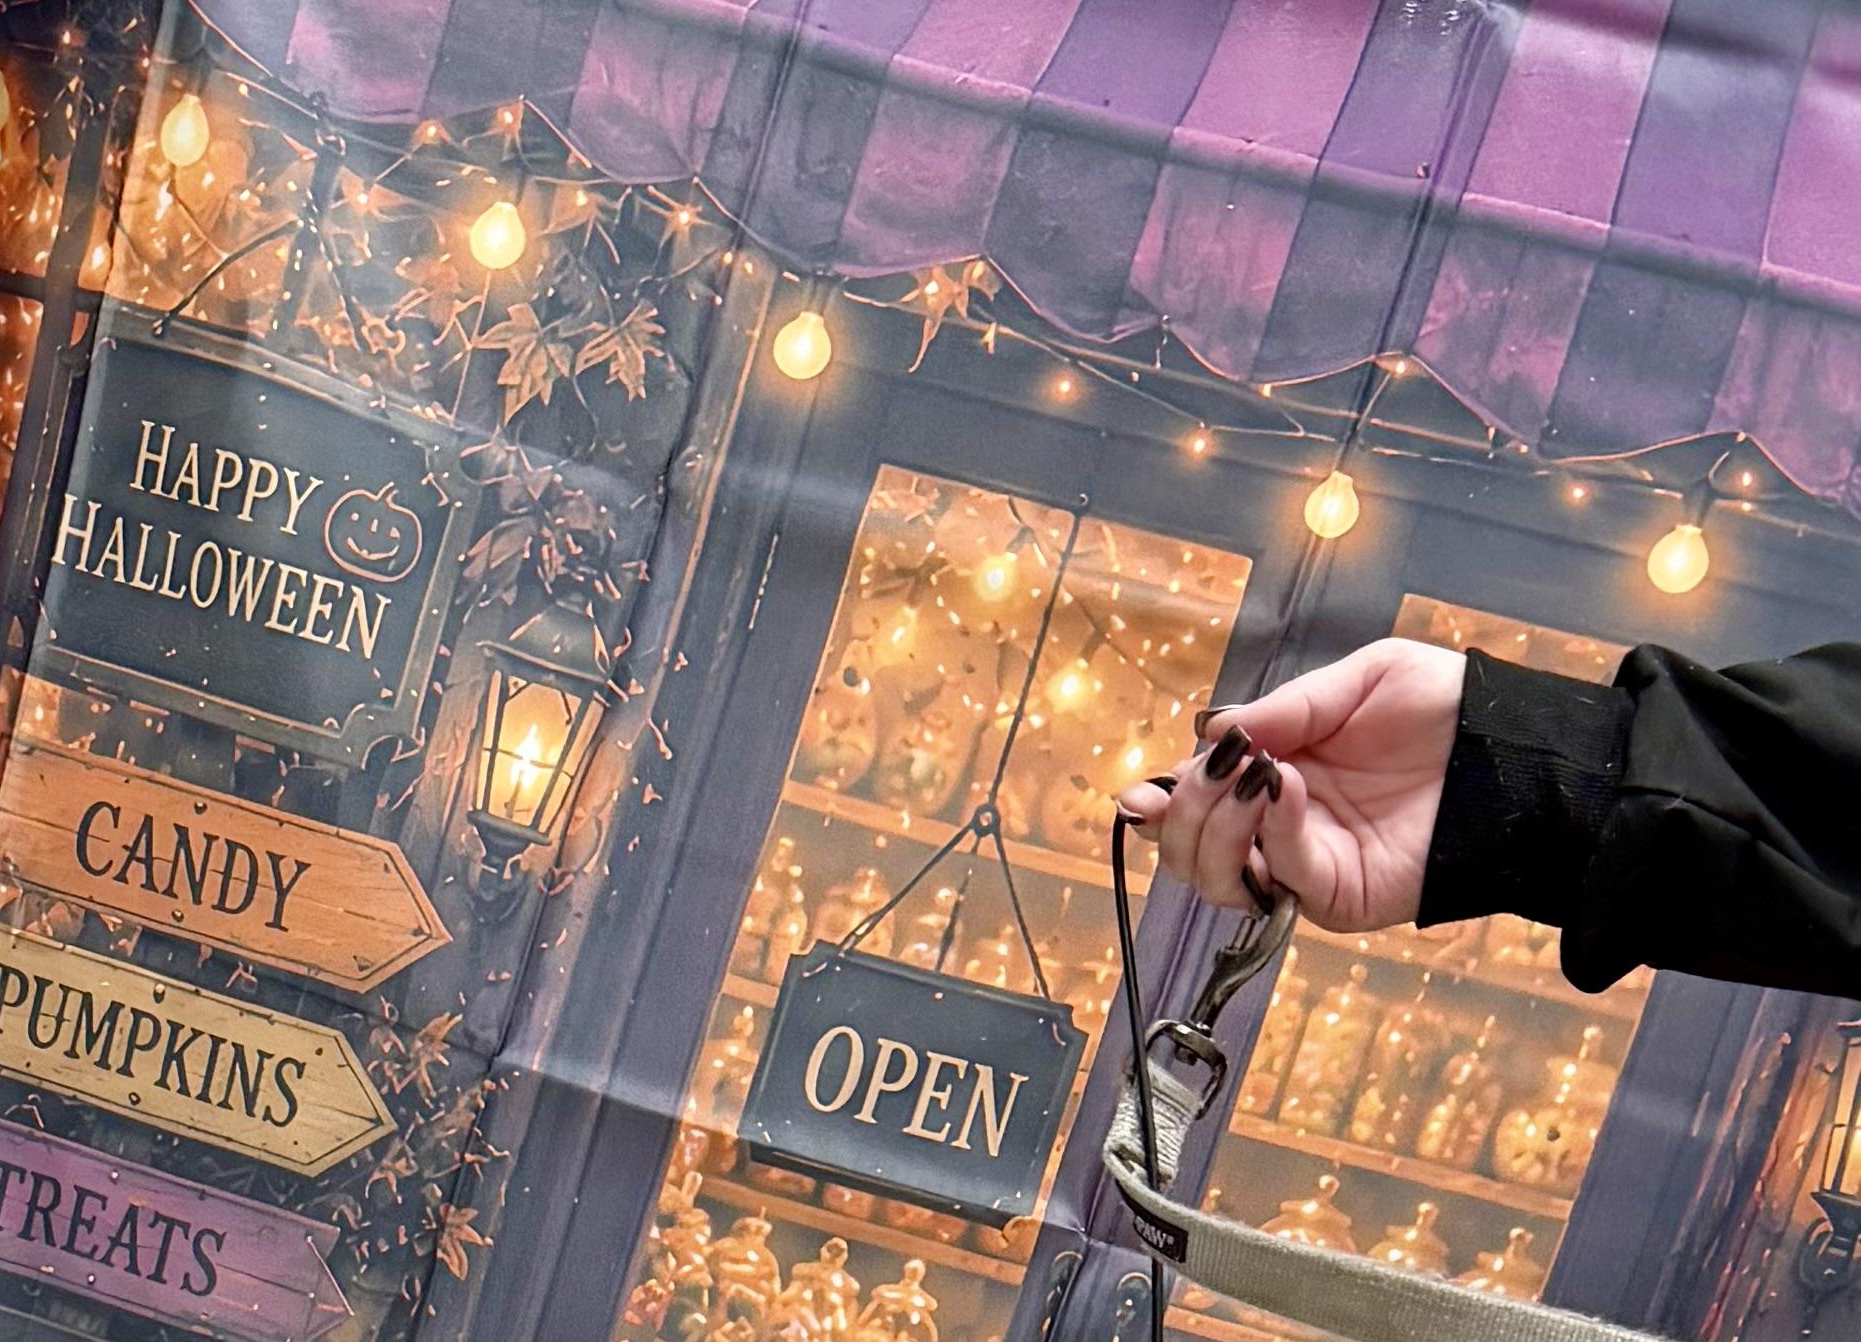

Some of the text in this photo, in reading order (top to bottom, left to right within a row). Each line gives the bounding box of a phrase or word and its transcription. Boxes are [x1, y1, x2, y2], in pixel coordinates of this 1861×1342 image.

[130, 420, 324, 536] HAPPY
[51, 494, 392, 660] HALLOWEEN
[76, 800, 312, 933] CANDY
[804, 1025, 1029, 1158] OPEN
